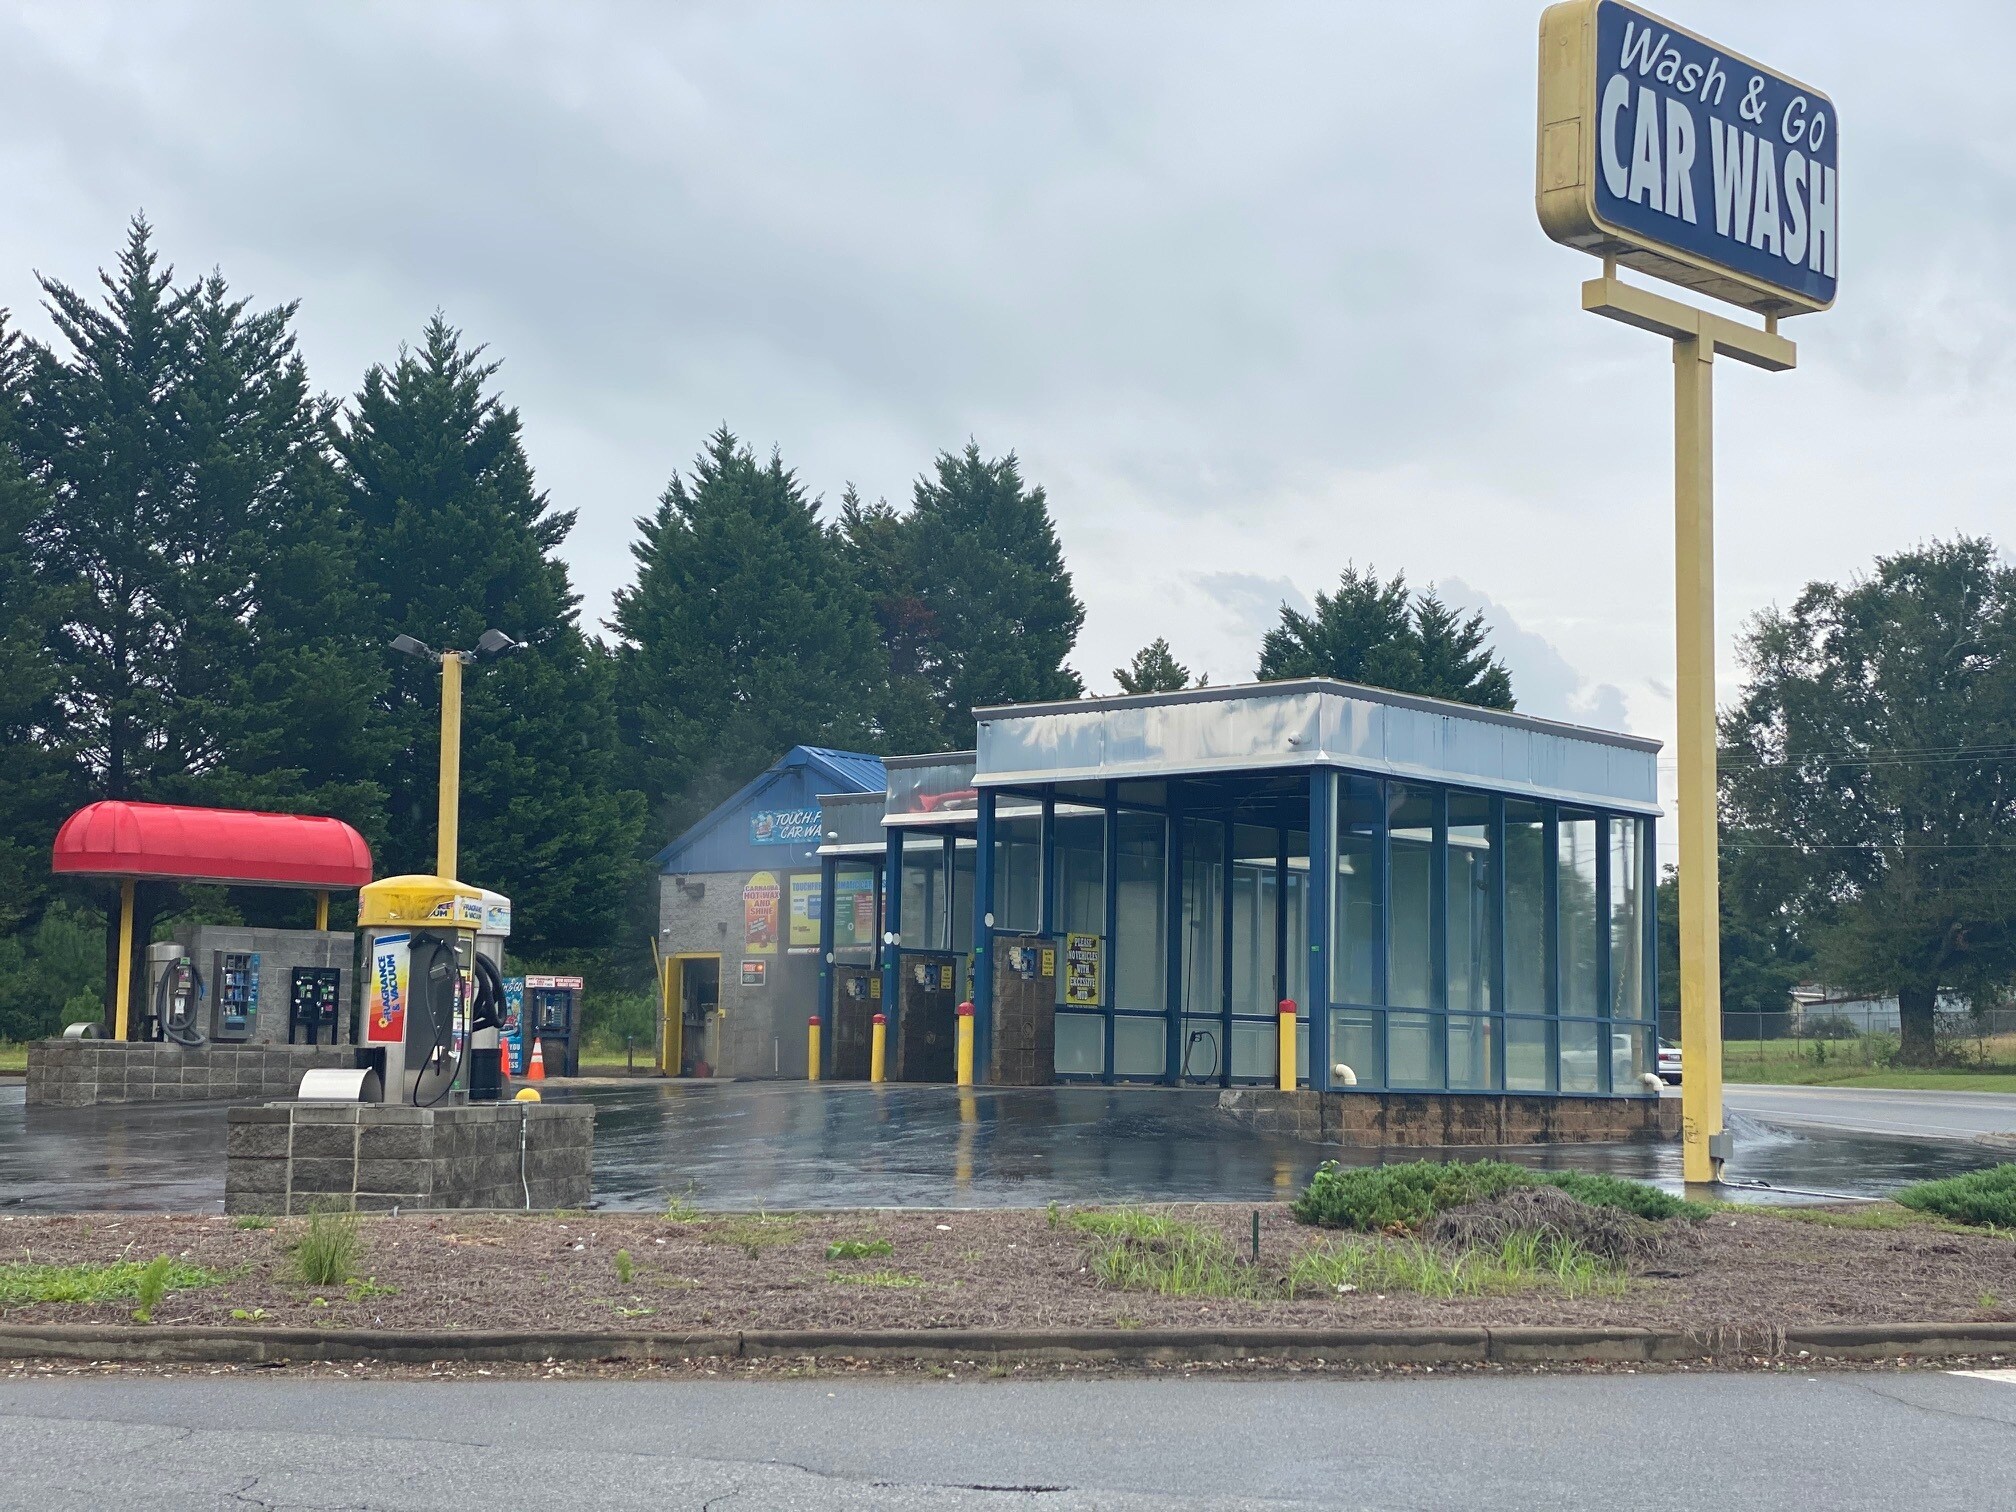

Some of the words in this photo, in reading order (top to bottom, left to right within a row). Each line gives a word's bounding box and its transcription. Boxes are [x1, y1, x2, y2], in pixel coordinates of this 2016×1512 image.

[1619, 21, 1727, 106] Wash
[1739, 75, 1767, 125] &
[1600, 73, 1698, 225] CAR
[1709, 116, 1837, 279] WASH
[780, 826, 803, 839] CAR
[744, 891, 760, 899] HOT
[762, 890, 779, 898] WAX
[754, 899, 771, 907] AND
[750, 907, 773, 915] SHINE
[1074, 937, 1092, 947] PLEASE
[1075, 950, 1098, 961] VEHICLES
[1076, 963, 1090, 974] WITH
[386, 953, 400, 1002] VACUUM
[1069, 976, 1095, 987] EXCESSIVE
[377, 955, 392, 1022] FRAGRANCE
[392, 1003, 400, 1012] &
[509, 1043, 521, 1051] YOU
